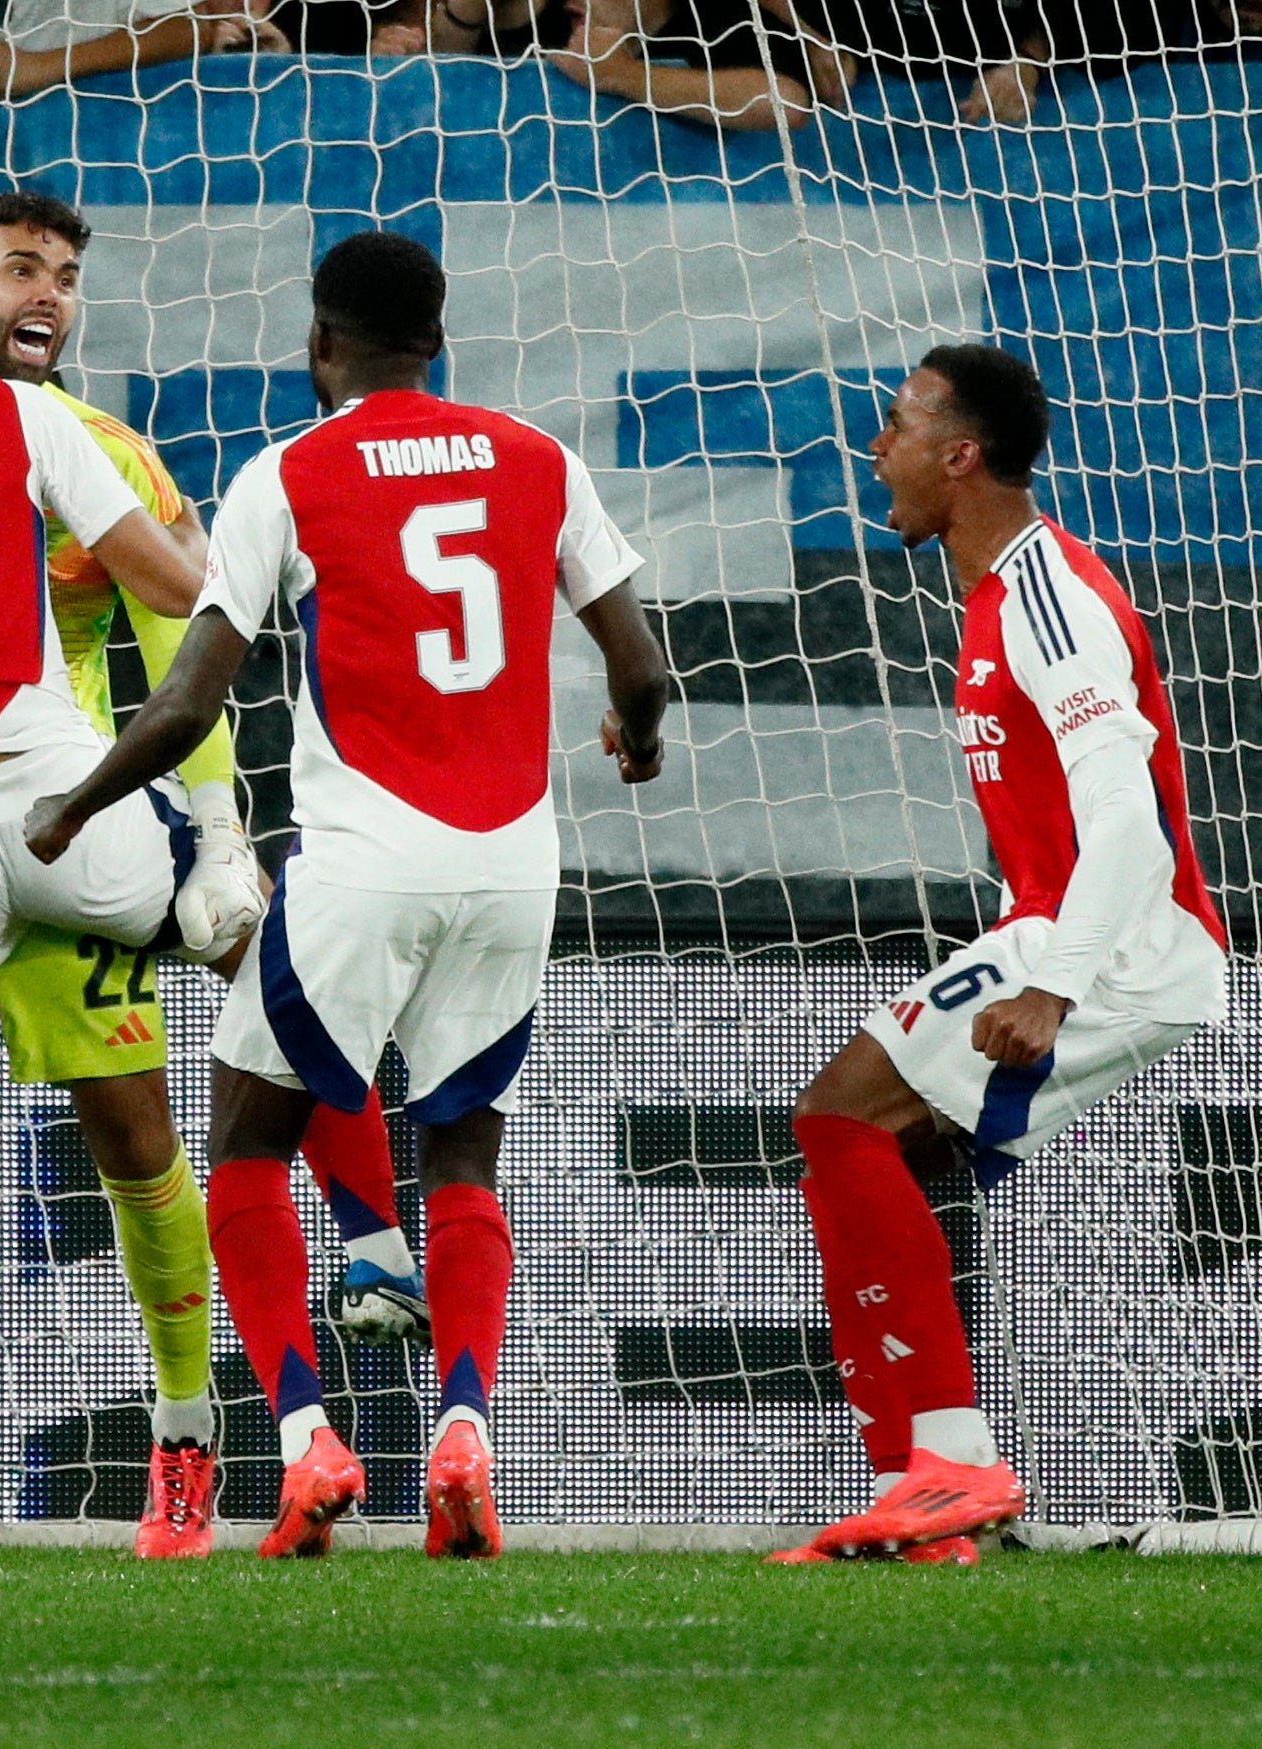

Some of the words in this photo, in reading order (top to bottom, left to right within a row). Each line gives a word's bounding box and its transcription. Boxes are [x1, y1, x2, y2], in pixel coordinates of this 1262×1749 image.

[356, 434, 496, 478] THOMAS
[399, 498, 506, 694] 5
[1054, 687, 1096, 716] VISIT
[77, 932, 156, 1011] 22
[929, 963, 1004, 1011] 6
[855, 1284, 889, 1308] FC
